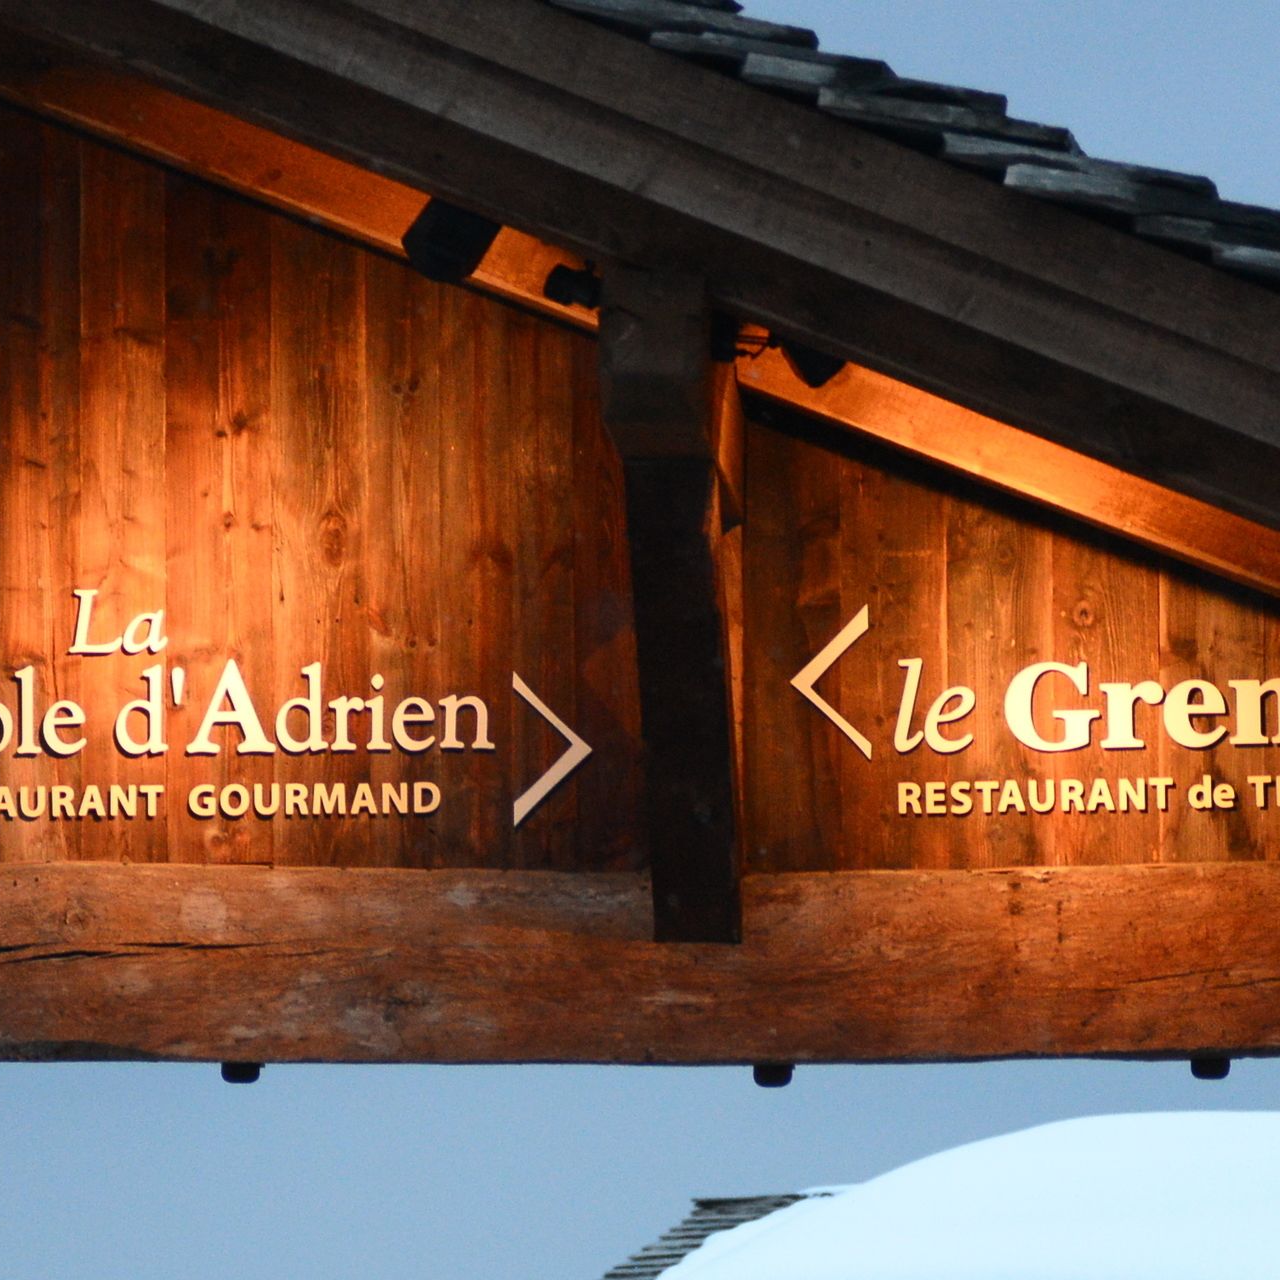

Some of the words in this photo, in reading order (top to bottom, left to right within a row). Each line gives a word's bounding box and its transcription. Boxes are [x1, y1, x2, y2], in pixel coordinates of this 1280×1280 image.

[69, 588, 168, 655] La
[115, 659, 496, 758] d'Adrien
[894, 657, 975, 753] le
[188, 780, 442, 817] GOURMAND
[898, 776, 1173, 815] RESTAURANT
[1188, 773, 1235, 810] de
